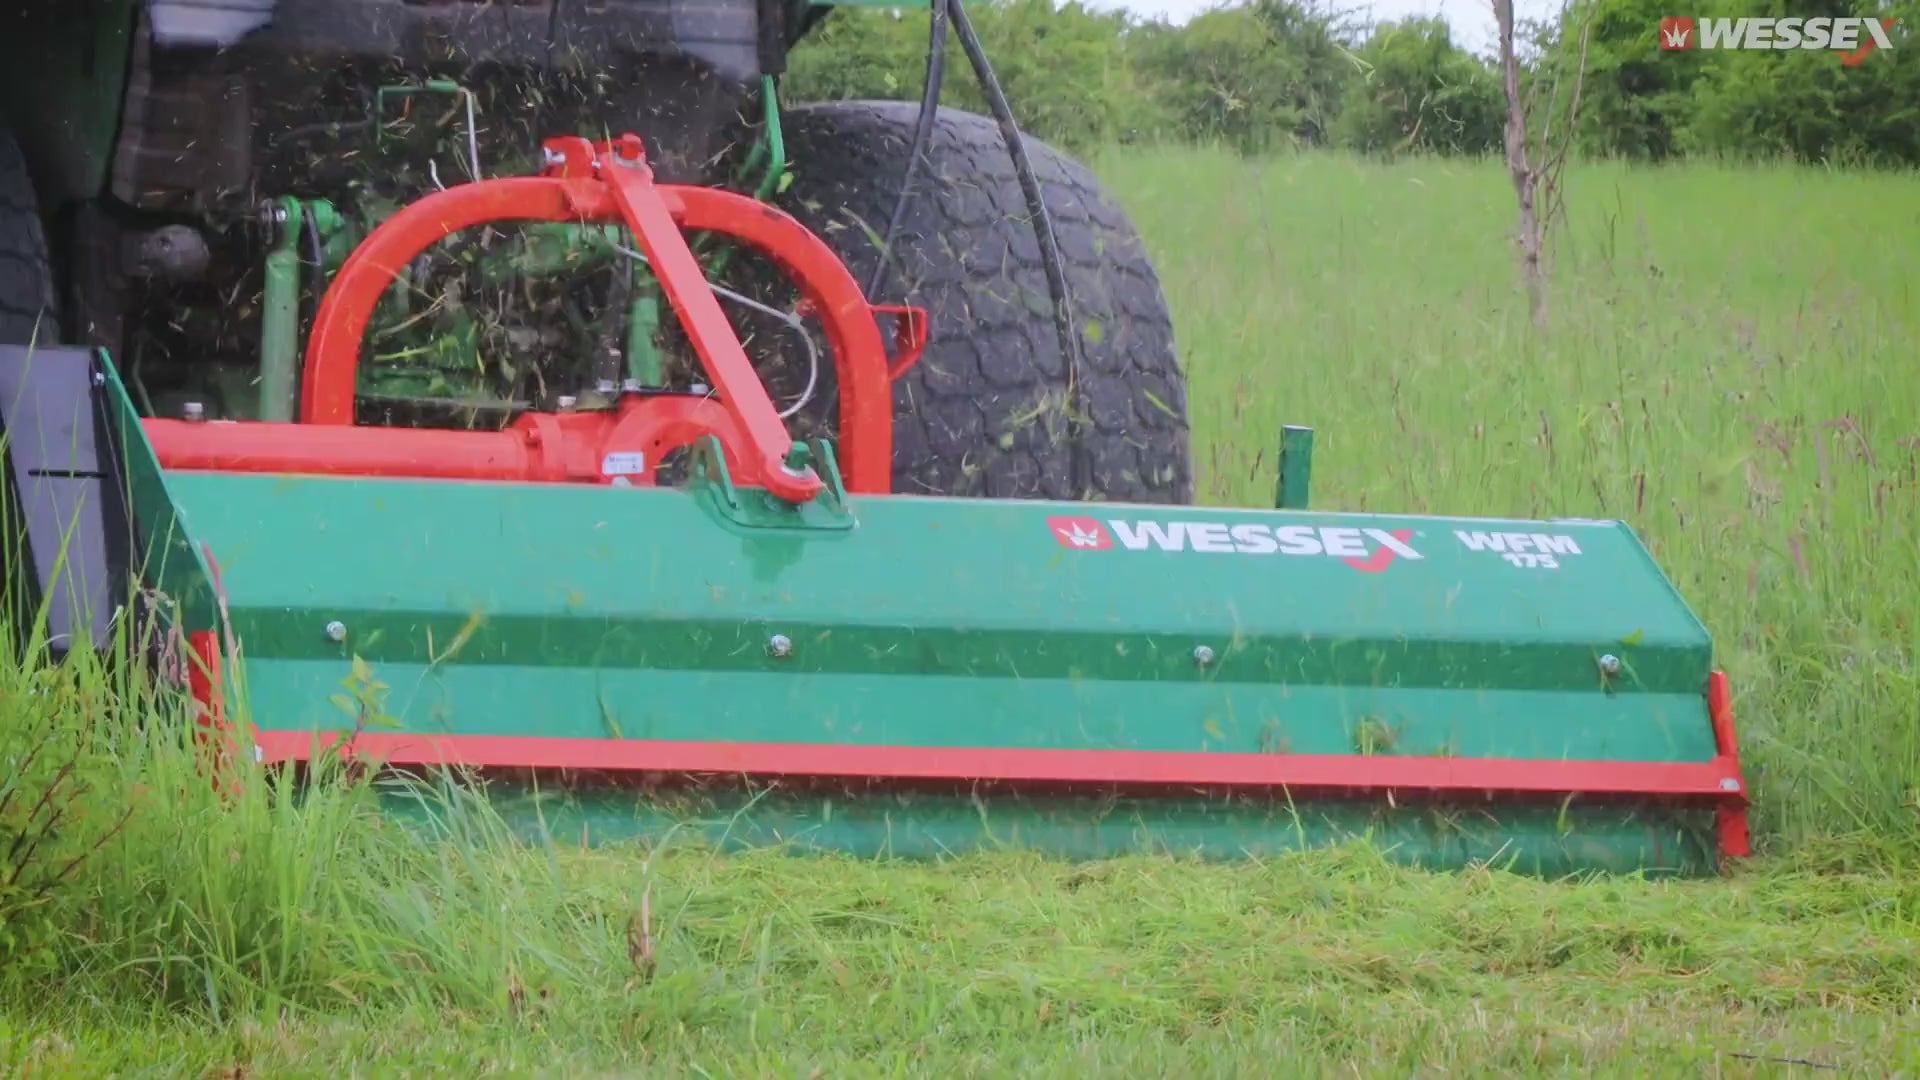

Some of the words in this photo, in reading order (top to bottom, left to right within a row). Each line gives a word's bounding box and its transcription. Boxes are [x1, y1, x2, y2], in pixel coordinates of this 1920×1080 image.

[1108, 519, 1424, 573] WESSEX
[1453, 530, 1582, 555] WFM
[1502, 552, 1560, 569] 175
